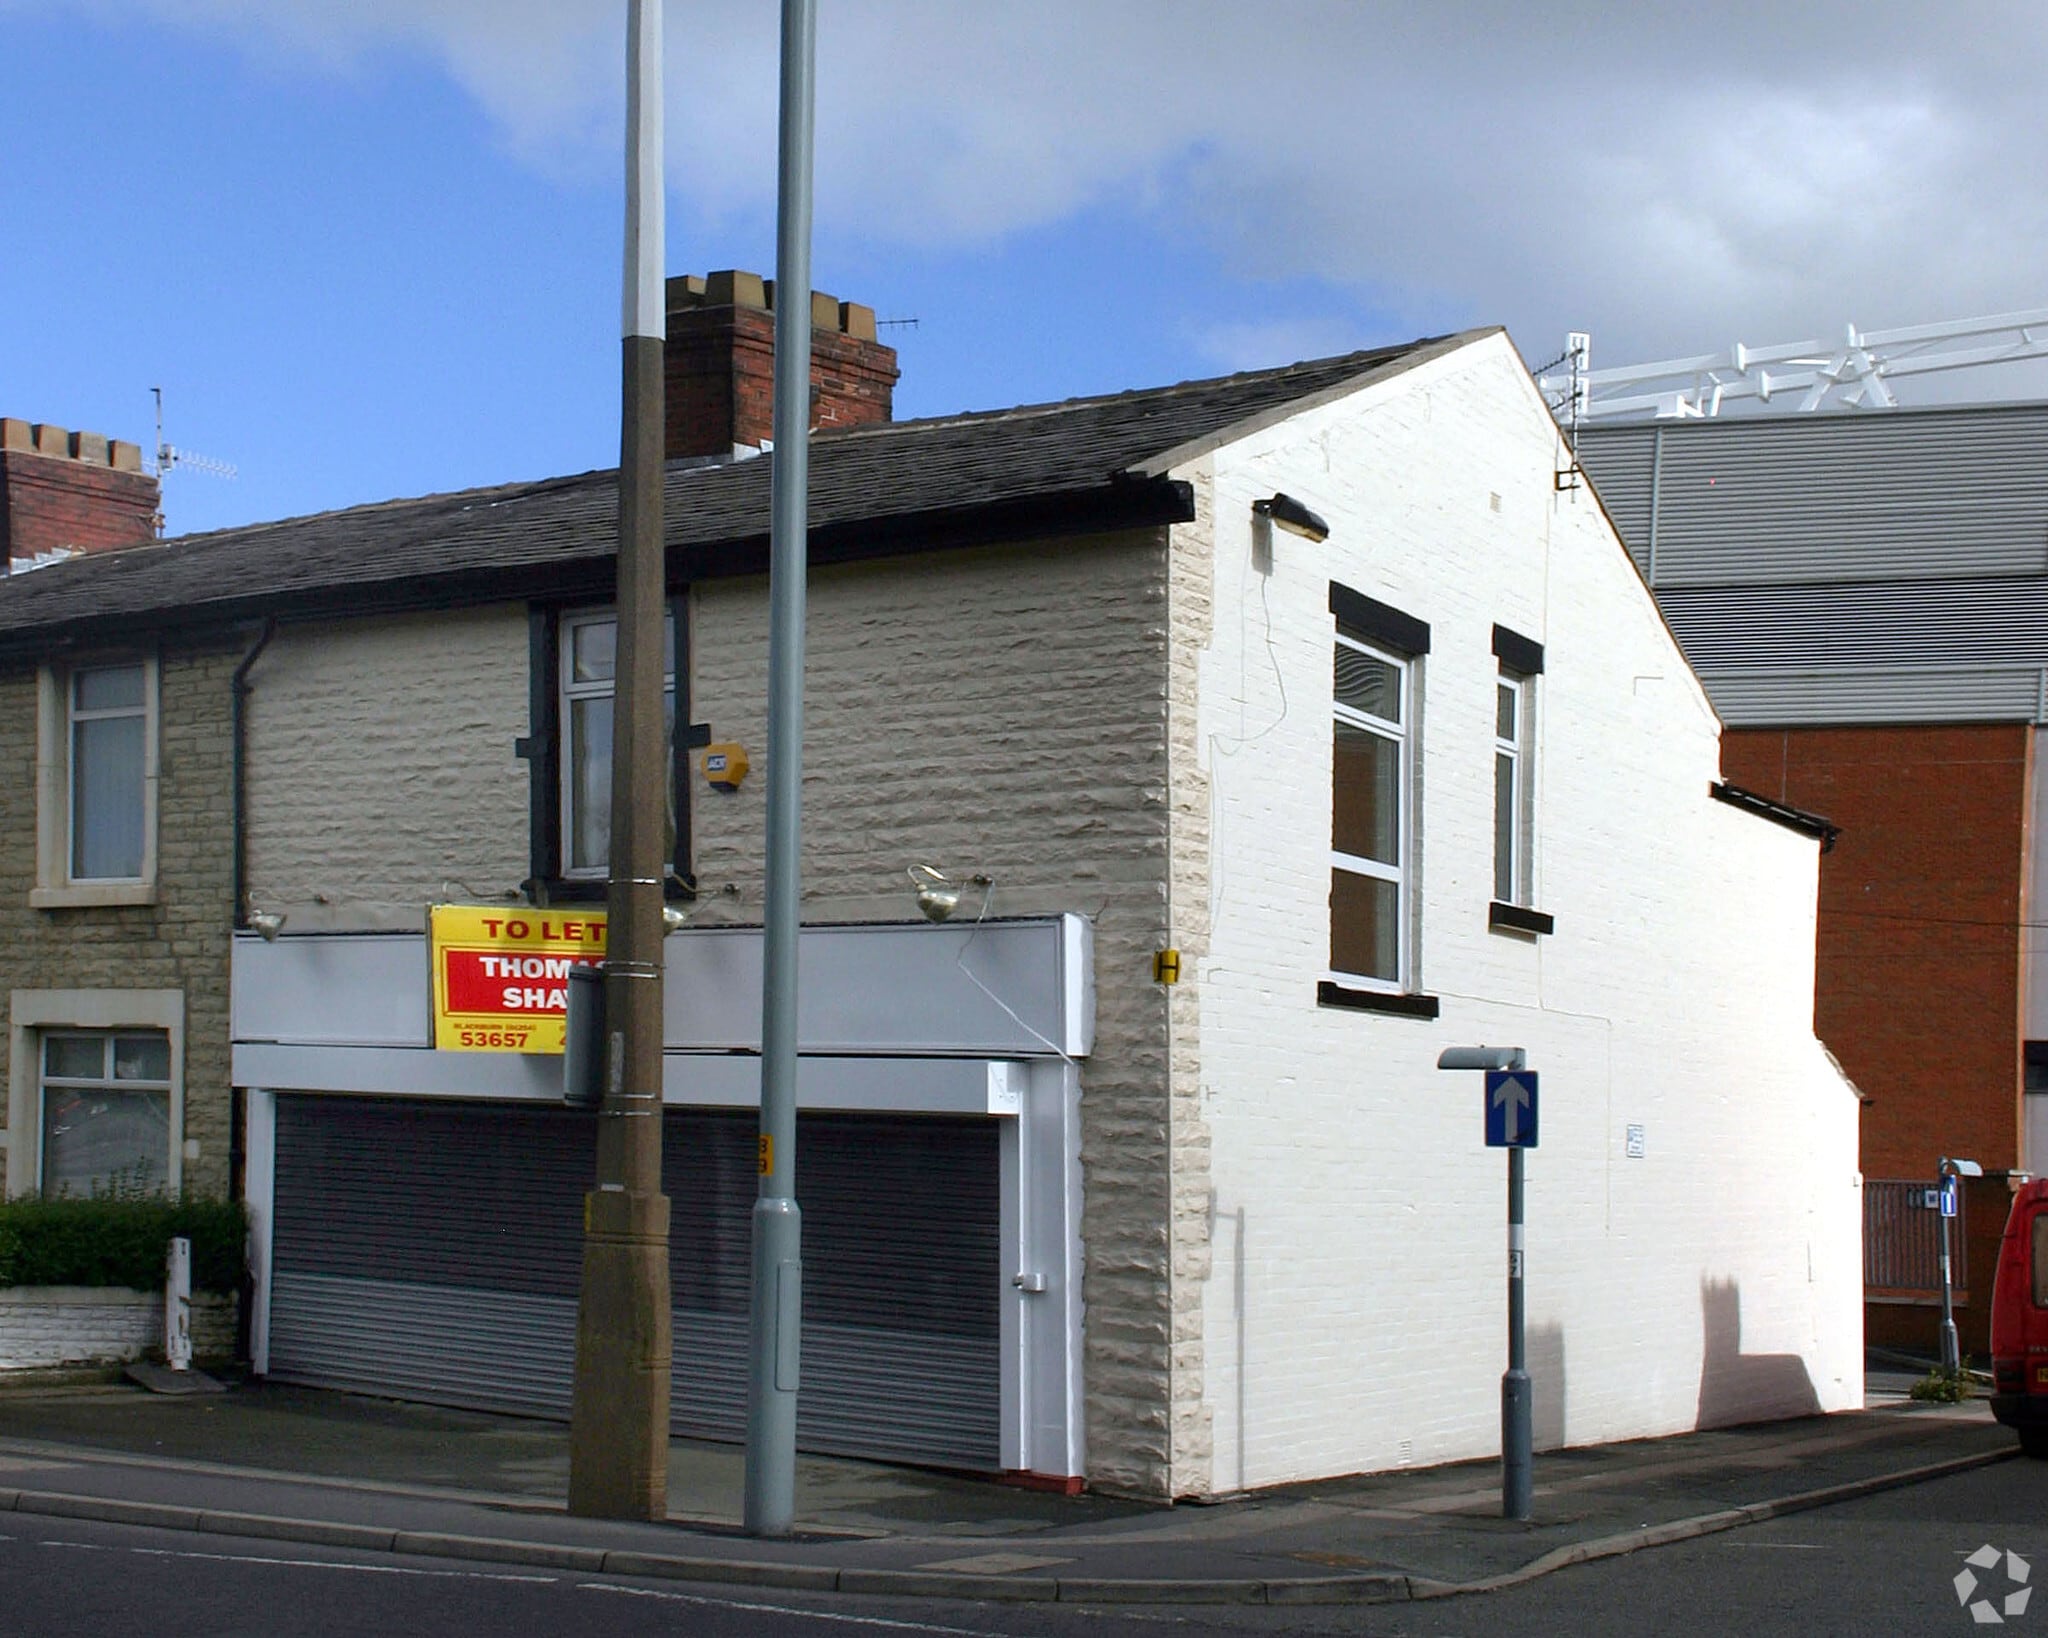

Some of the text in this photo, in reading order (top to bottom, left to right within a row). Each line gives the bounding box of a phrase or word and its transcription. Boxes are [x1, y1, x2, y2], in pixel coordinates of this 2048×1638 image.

[482, 919, 608, 941] TO LET
[479, 956, 605, 979] THOM
[1158, 951, 1179, 983] H
[502, 986, 568, 1009] SHA
[460, 1031, 529, 1048] 53657
